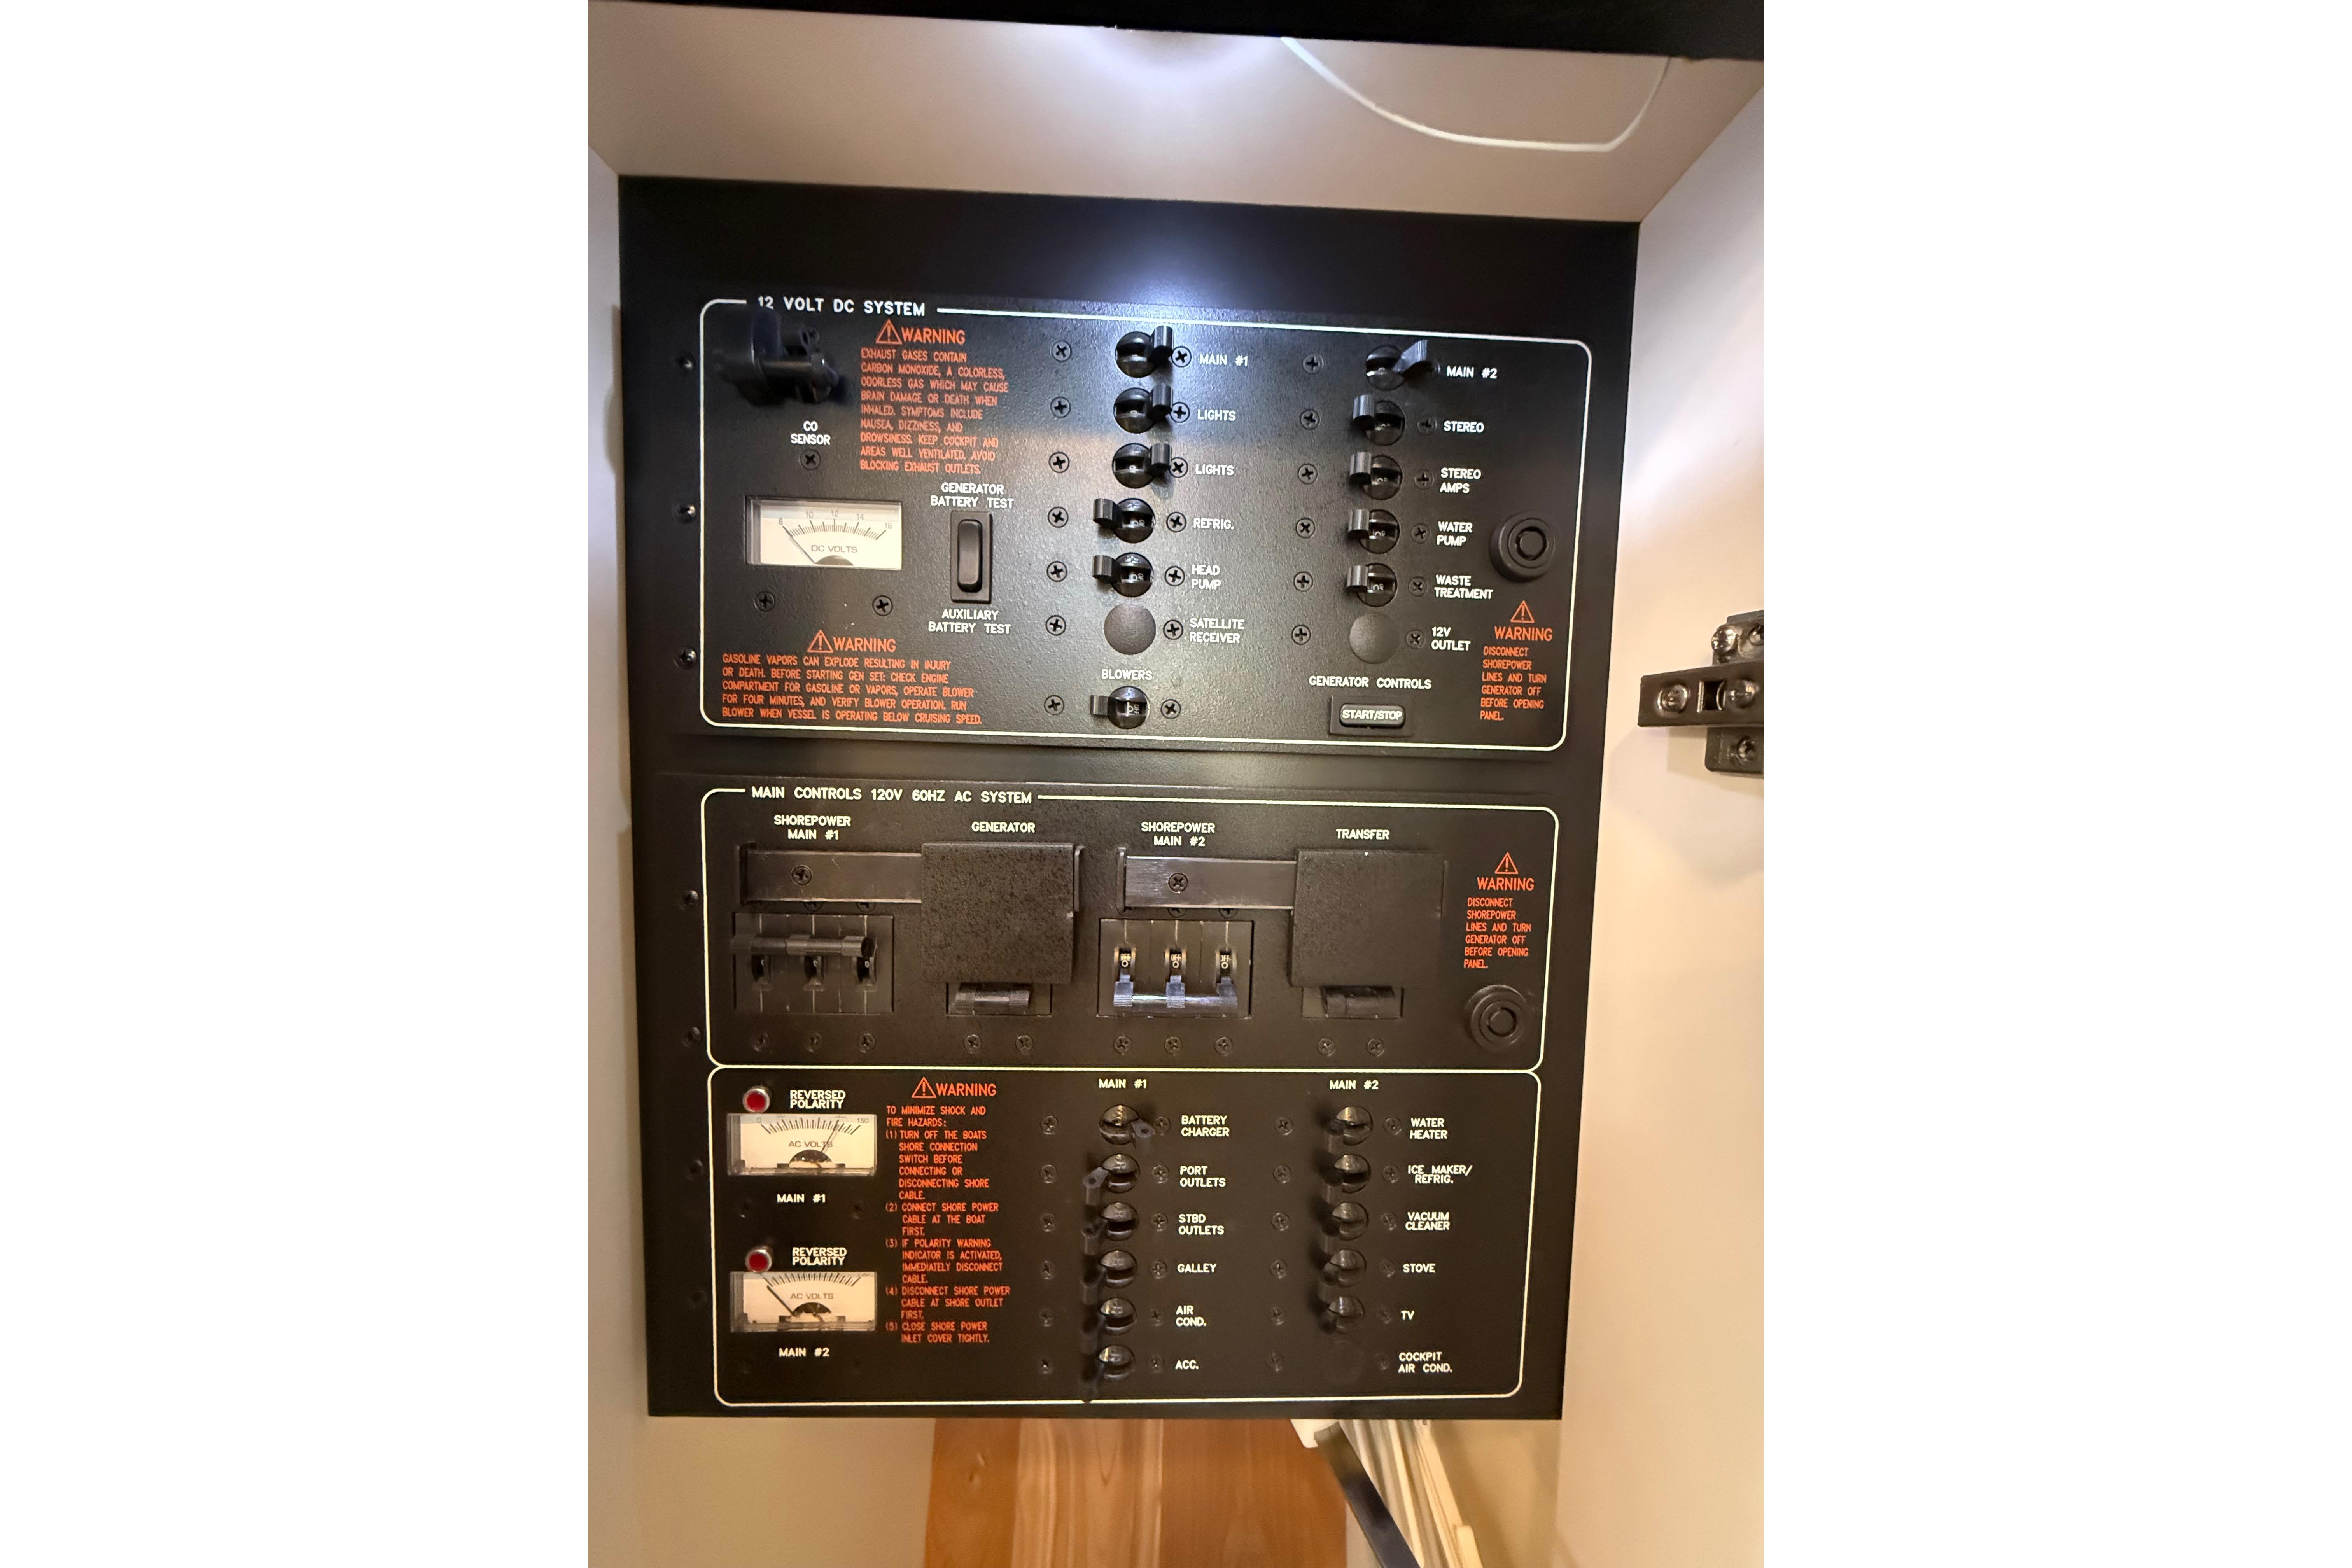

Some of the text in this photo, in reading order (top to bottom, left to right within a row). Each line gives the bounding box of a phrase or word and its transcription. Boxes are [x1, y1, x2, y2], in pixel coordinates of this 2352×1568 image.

[759, 296, 925, 316] 12 VOLT DC SYSTEM
[902, 327, 965, 344] WARNING
[861, 348, 967, 362] EXHAUST GASES CONTAIN
[1199, 354, 1248, 366] MAIN #1
[861, 362, 1004, 379] CARBON MONOXIDE, A COLORLESS,
[1447, 366, 1497, 378] MAIN #2
[1197, 409, 1236, 421] LIGHTS
[803, 421, 818, 432] CO
[1444, 421, 1484, 433] STEREO
[791, 433, 830, 445] SENSOR
[1195, 464, 1234, 476] LIGHTS
[1441, 467, 1481, 479] STEREO
[942, 483, 1004, 495] GENERATOR
[1440, 482, 1469, 494] AMPS
[931, 495, 1014, 509] BATTERY TEST
[1193, 518, 1234, 530] REFRIG.
[1438, 522, 1473, 533] WATER
[1437, 535, 1466, 546] PUMP
[1192, 565, 1220, 576] HEAD
[1191, 579, 1221, 590] PUMP
[1436, 574, 1472, 586] WASTE
[1434, 587, 1493, 599] TREATMENT
[942, 609, 999, 621] AUXILIARY
[928, 621, 1012, 634] BATTERY TEST
[1190, 618, 1244, 630] SATELLITE
[1432, 627, 1451, 637] 12V
[1495, 626, 1553, 641] WARNING
[1190, 632, 1241, 644] RECEIVER
[833, 637, 896, 652] WARNING
[1432, 640, 1470, 651] OUTLET
[1484, 646, 1528, 656] DISCONNECT
[723, 653, 950, 670] GASOLINE VAPORS CAN EXPLODE RESULTING IN INJURY
[1483, 659, 1532, 669] SHOREPOWER
[1101, 669, 1152, 680] BLOWERS
[1482, 672, 1547, 683] LINES AND TURN
[1309, 676, 1431, 689] GENERATOR CONTROLS
[1482, 684, 1540, 695] GENERATOR OFF
[1481, 697, 1544, 709] BEFORE OPENING
[1342, 709, 1402, 720] START/STOP
[1481, 710, 1502, 720] PANEL.
[752, 786, 1032, 803] MAIN CONTROLS 120V 60HZ AC SYSTEM
[774, 815, 851, 826] SHOREPOWER
[971, 822, 1035, 833] GENERATOR
[1141, 821, 1215, 833] SHOREPOWER
[788, 829, 838, 840] MAIN #1
[1336, 828, 1390, 840] TRANSFER
[1154, 836, 1205, 847] MAIN #2
[1478, 877, 1535, 891] WARNING
[1468, 898, 1512, 907] DISCONNECT
[1468, 910, 1516, 920] SHOREPOWER
[1467, 922, 1531, 932] LINES AND TURN
[1466, 934, 1525, 944] GENERATOR OFF
[1465, 947, 1529, 956] BEFORE OPENING
[1464, 959, 1486, 968] PANEL.
[1099, 1078, 1146, 1088] MAIN #1
[1329, 1080, 1378, 1090] MAIN #2
[790, 1090, 846, 1099] REVERSED
[936, 1083, 996, 1097] WARNING
[790, 1099, 844, 1109] POLARITY
[887, 1106, 986, 1115] TO MINIMIZE SHOCK AND
[887, 1117, 947, 1127] FIRE HAZARDS:
[1181, 1115, 1227, 1125] BATTERY
[1411, 1118, 1444, 1127] WATER
[886, 1130, 986, 1139] (1) TURN OFF THE BOATS
[1181, 1127, 1230, 1137] CHARGER
[1410, 1130, 1447, 1139] HEATER
[1180, 1166, 1208, 1175] PORT
[1408, 1165, 1473, 1176] ICE MAKER/
[1180, 1178, 1226, 1187] OUTLETS
[1415, 1174, 1454, 1184] REFRIG.
[777, 1194, 825, 1203] MAIN #1
[1179, 1214, 1206, 1223] STBD
[1407, 1212, 1449, 1221] VACUUM
[1178, 1225, 1224, 1235] OUTLETS
[1405, 1221, 1450, 1230] CLEANER
[792, 1247, 847, 1256] REVERSED
[792, 1256, 845, 1266] POLARITY
[1177, 1263, 1216, 1273] GALLEY
[1403, 1264, 1436, 1273] STOVE
[1176, 1305, 1194, 1315] AIR
[1401, 1310, 1414, 1320] TV
[1176, 1317, 1206, 1326] COND.
[779, 1348, 830, 1357] MAIN #2
[1399, 1352, 1442, 1362] COCKPIT
[1175, 1360, 1199, 1369] ACC.
[1398, 1363, 1452, 1373] AIR COND.
